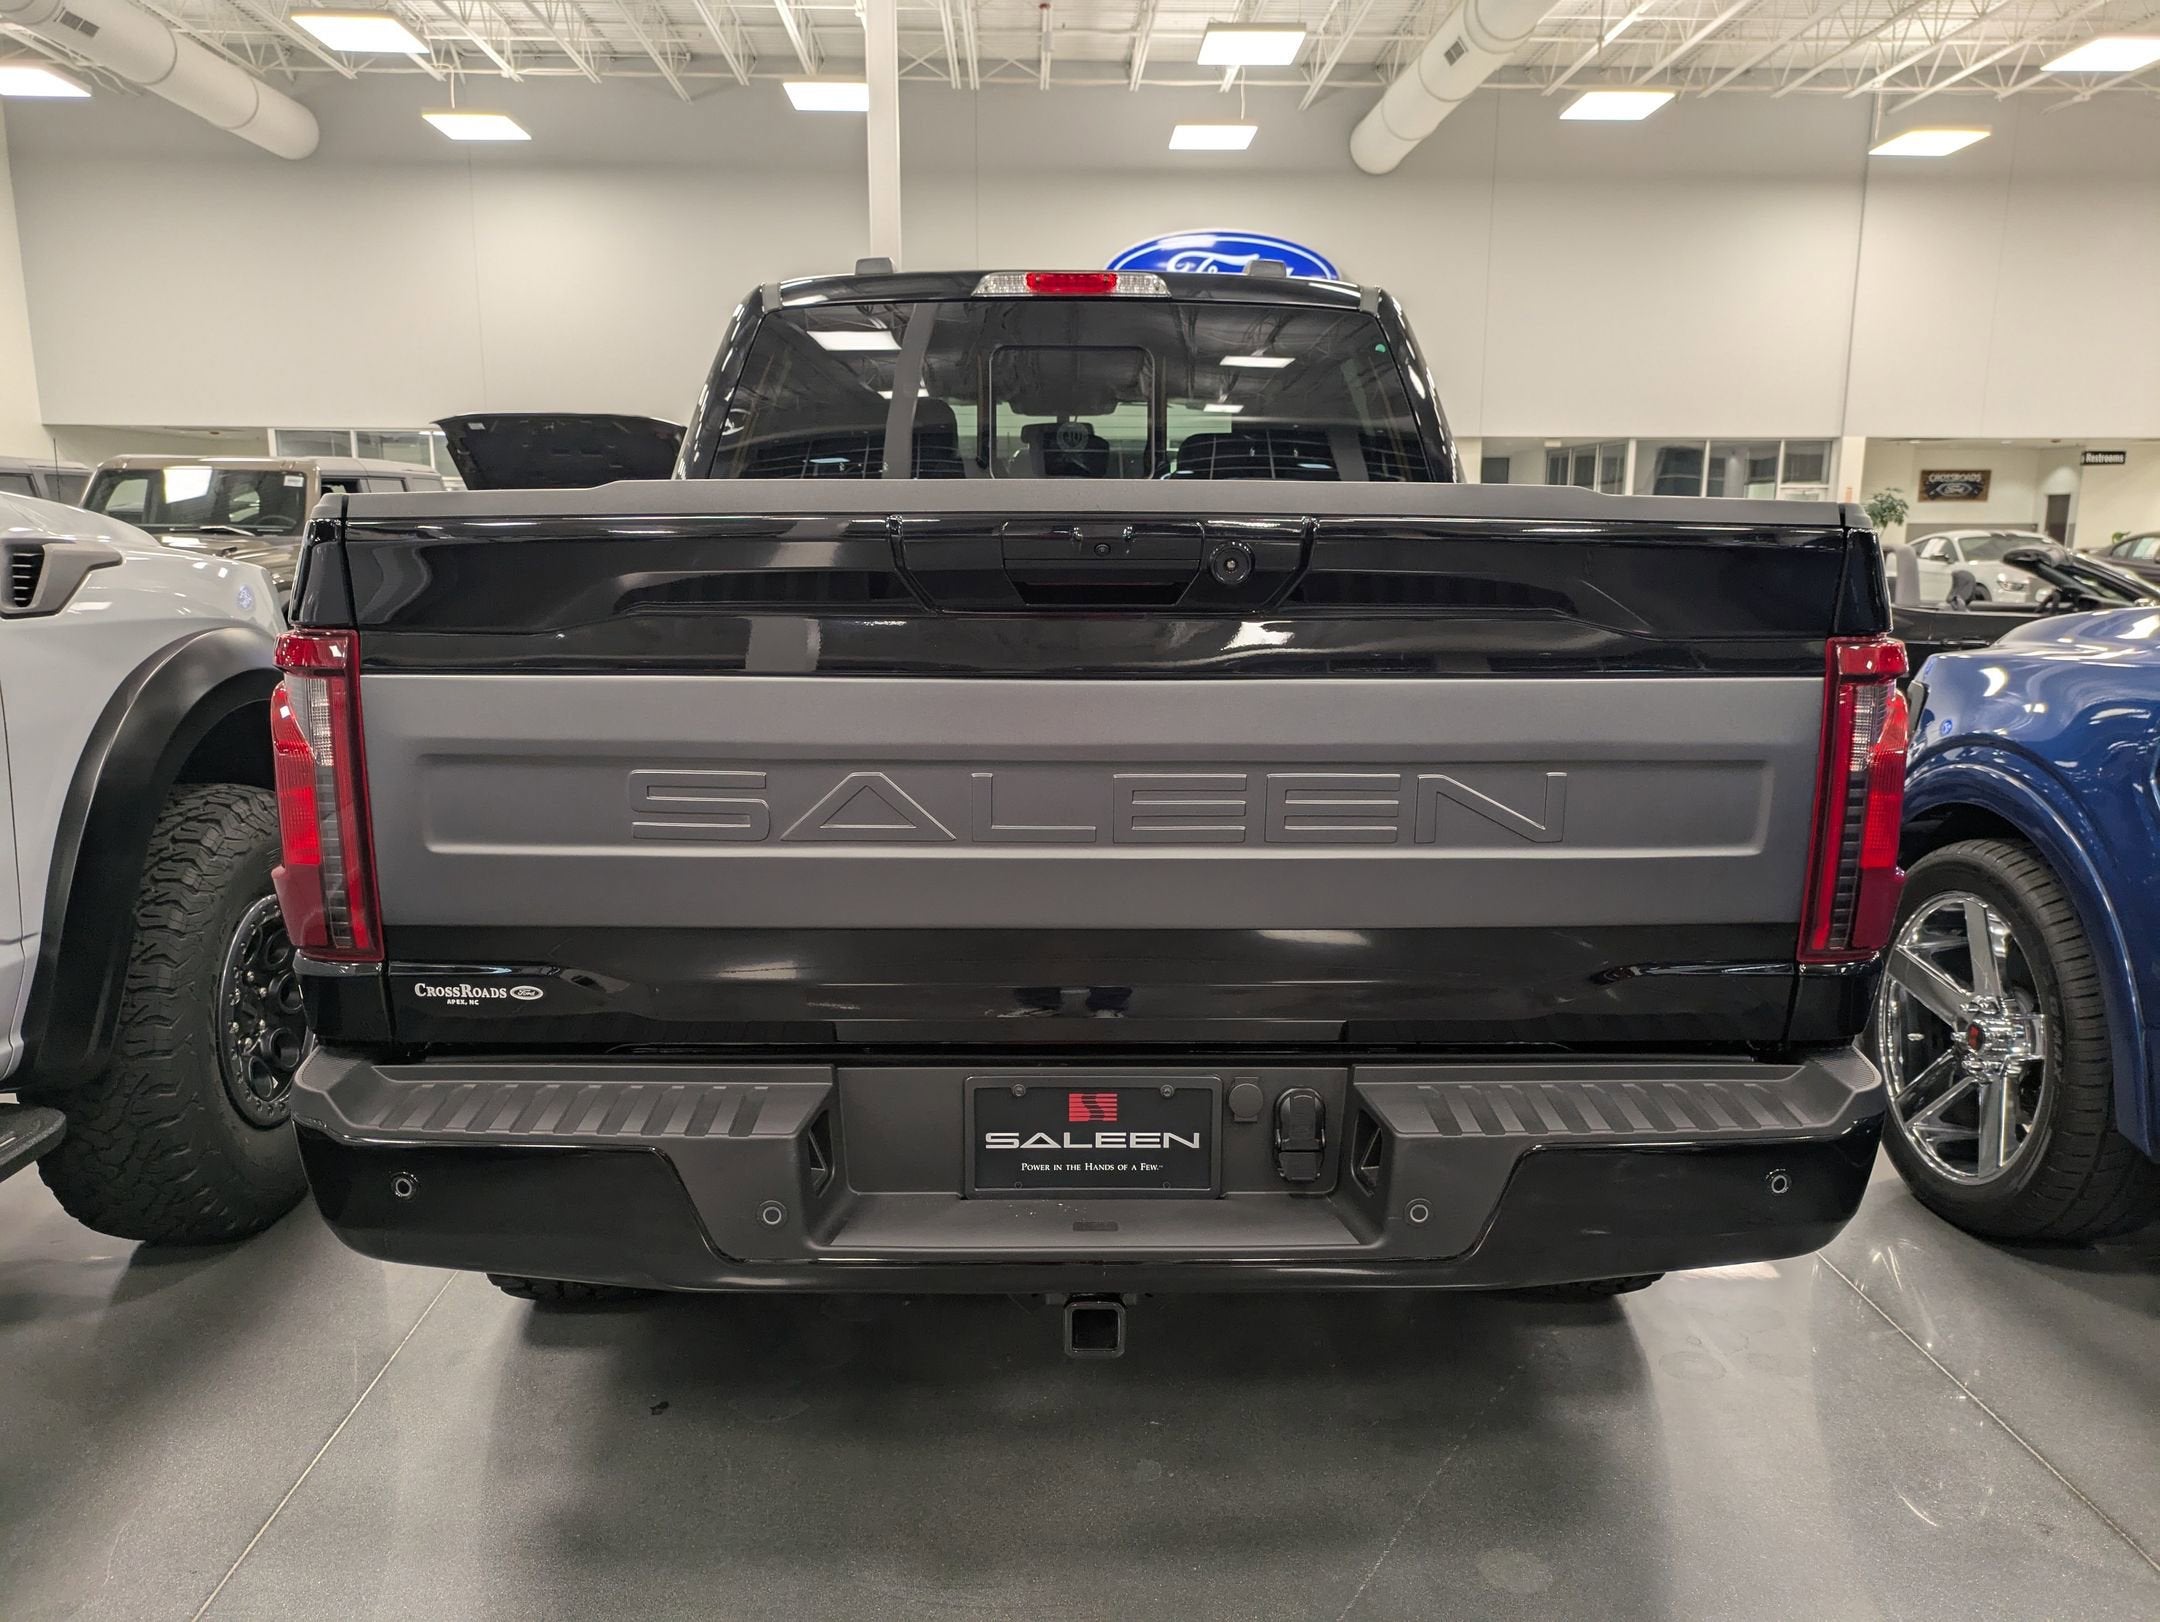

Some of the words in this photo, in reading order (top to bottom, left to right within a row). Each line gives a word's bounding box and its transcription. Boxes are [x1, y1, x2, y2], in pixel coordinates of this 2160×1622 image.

[2086, 453, 2124, 463] Restrooms
[629, 769, 1568, 843] SALEEN
[985, 1132, 1200, 1149] SALEEN
